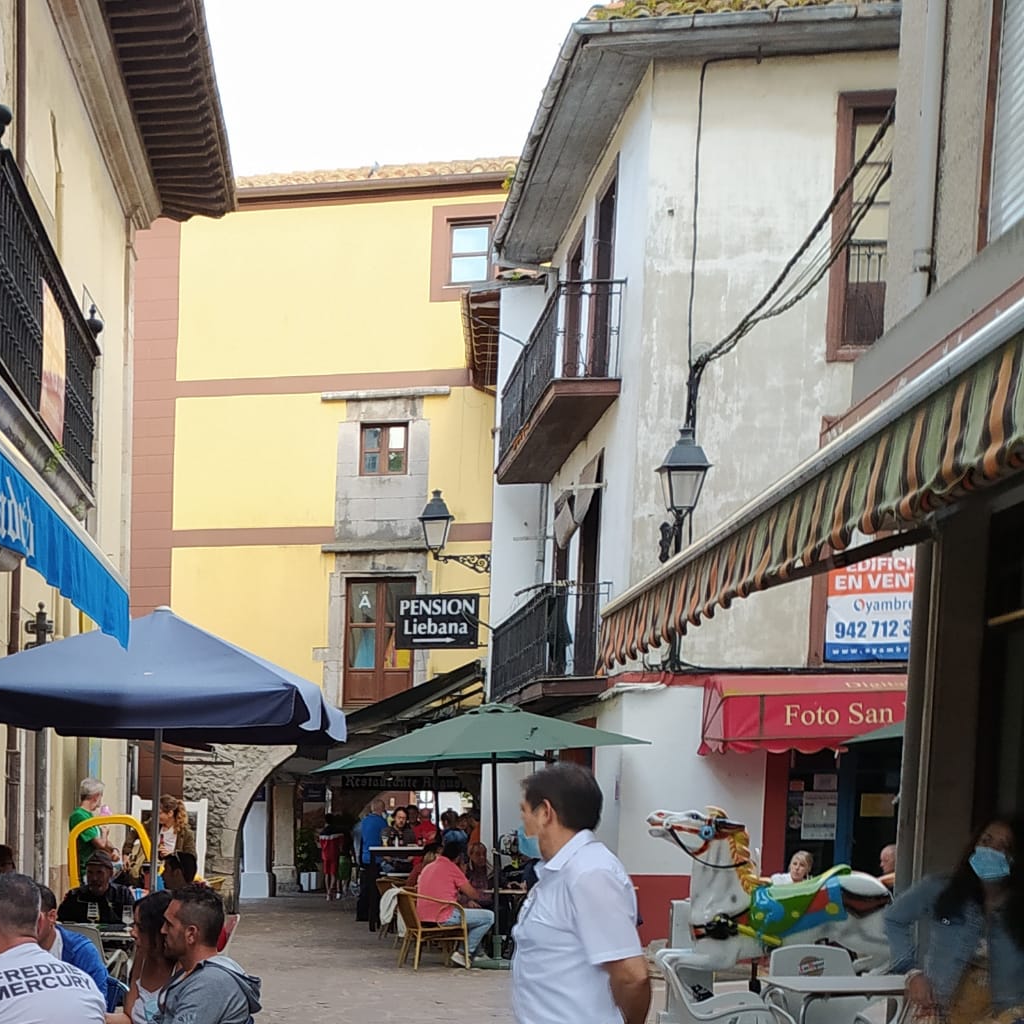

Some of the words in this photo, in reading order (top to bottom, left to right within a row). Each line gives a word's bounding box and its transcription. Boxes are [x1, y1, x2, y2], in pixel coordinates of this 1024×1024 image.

[845, 557, 915, 573] EDIFICI
[835, 574, 862, 591] EN
[399, 598, 475, 616] PENSION
[403, 617, 469, 635] Liebana
[834, 620, 868, 639] 942
[872, 620, 899, 638] 712
[784, 704, 840, 727] Foto
[848, 702, 894, 725] San
